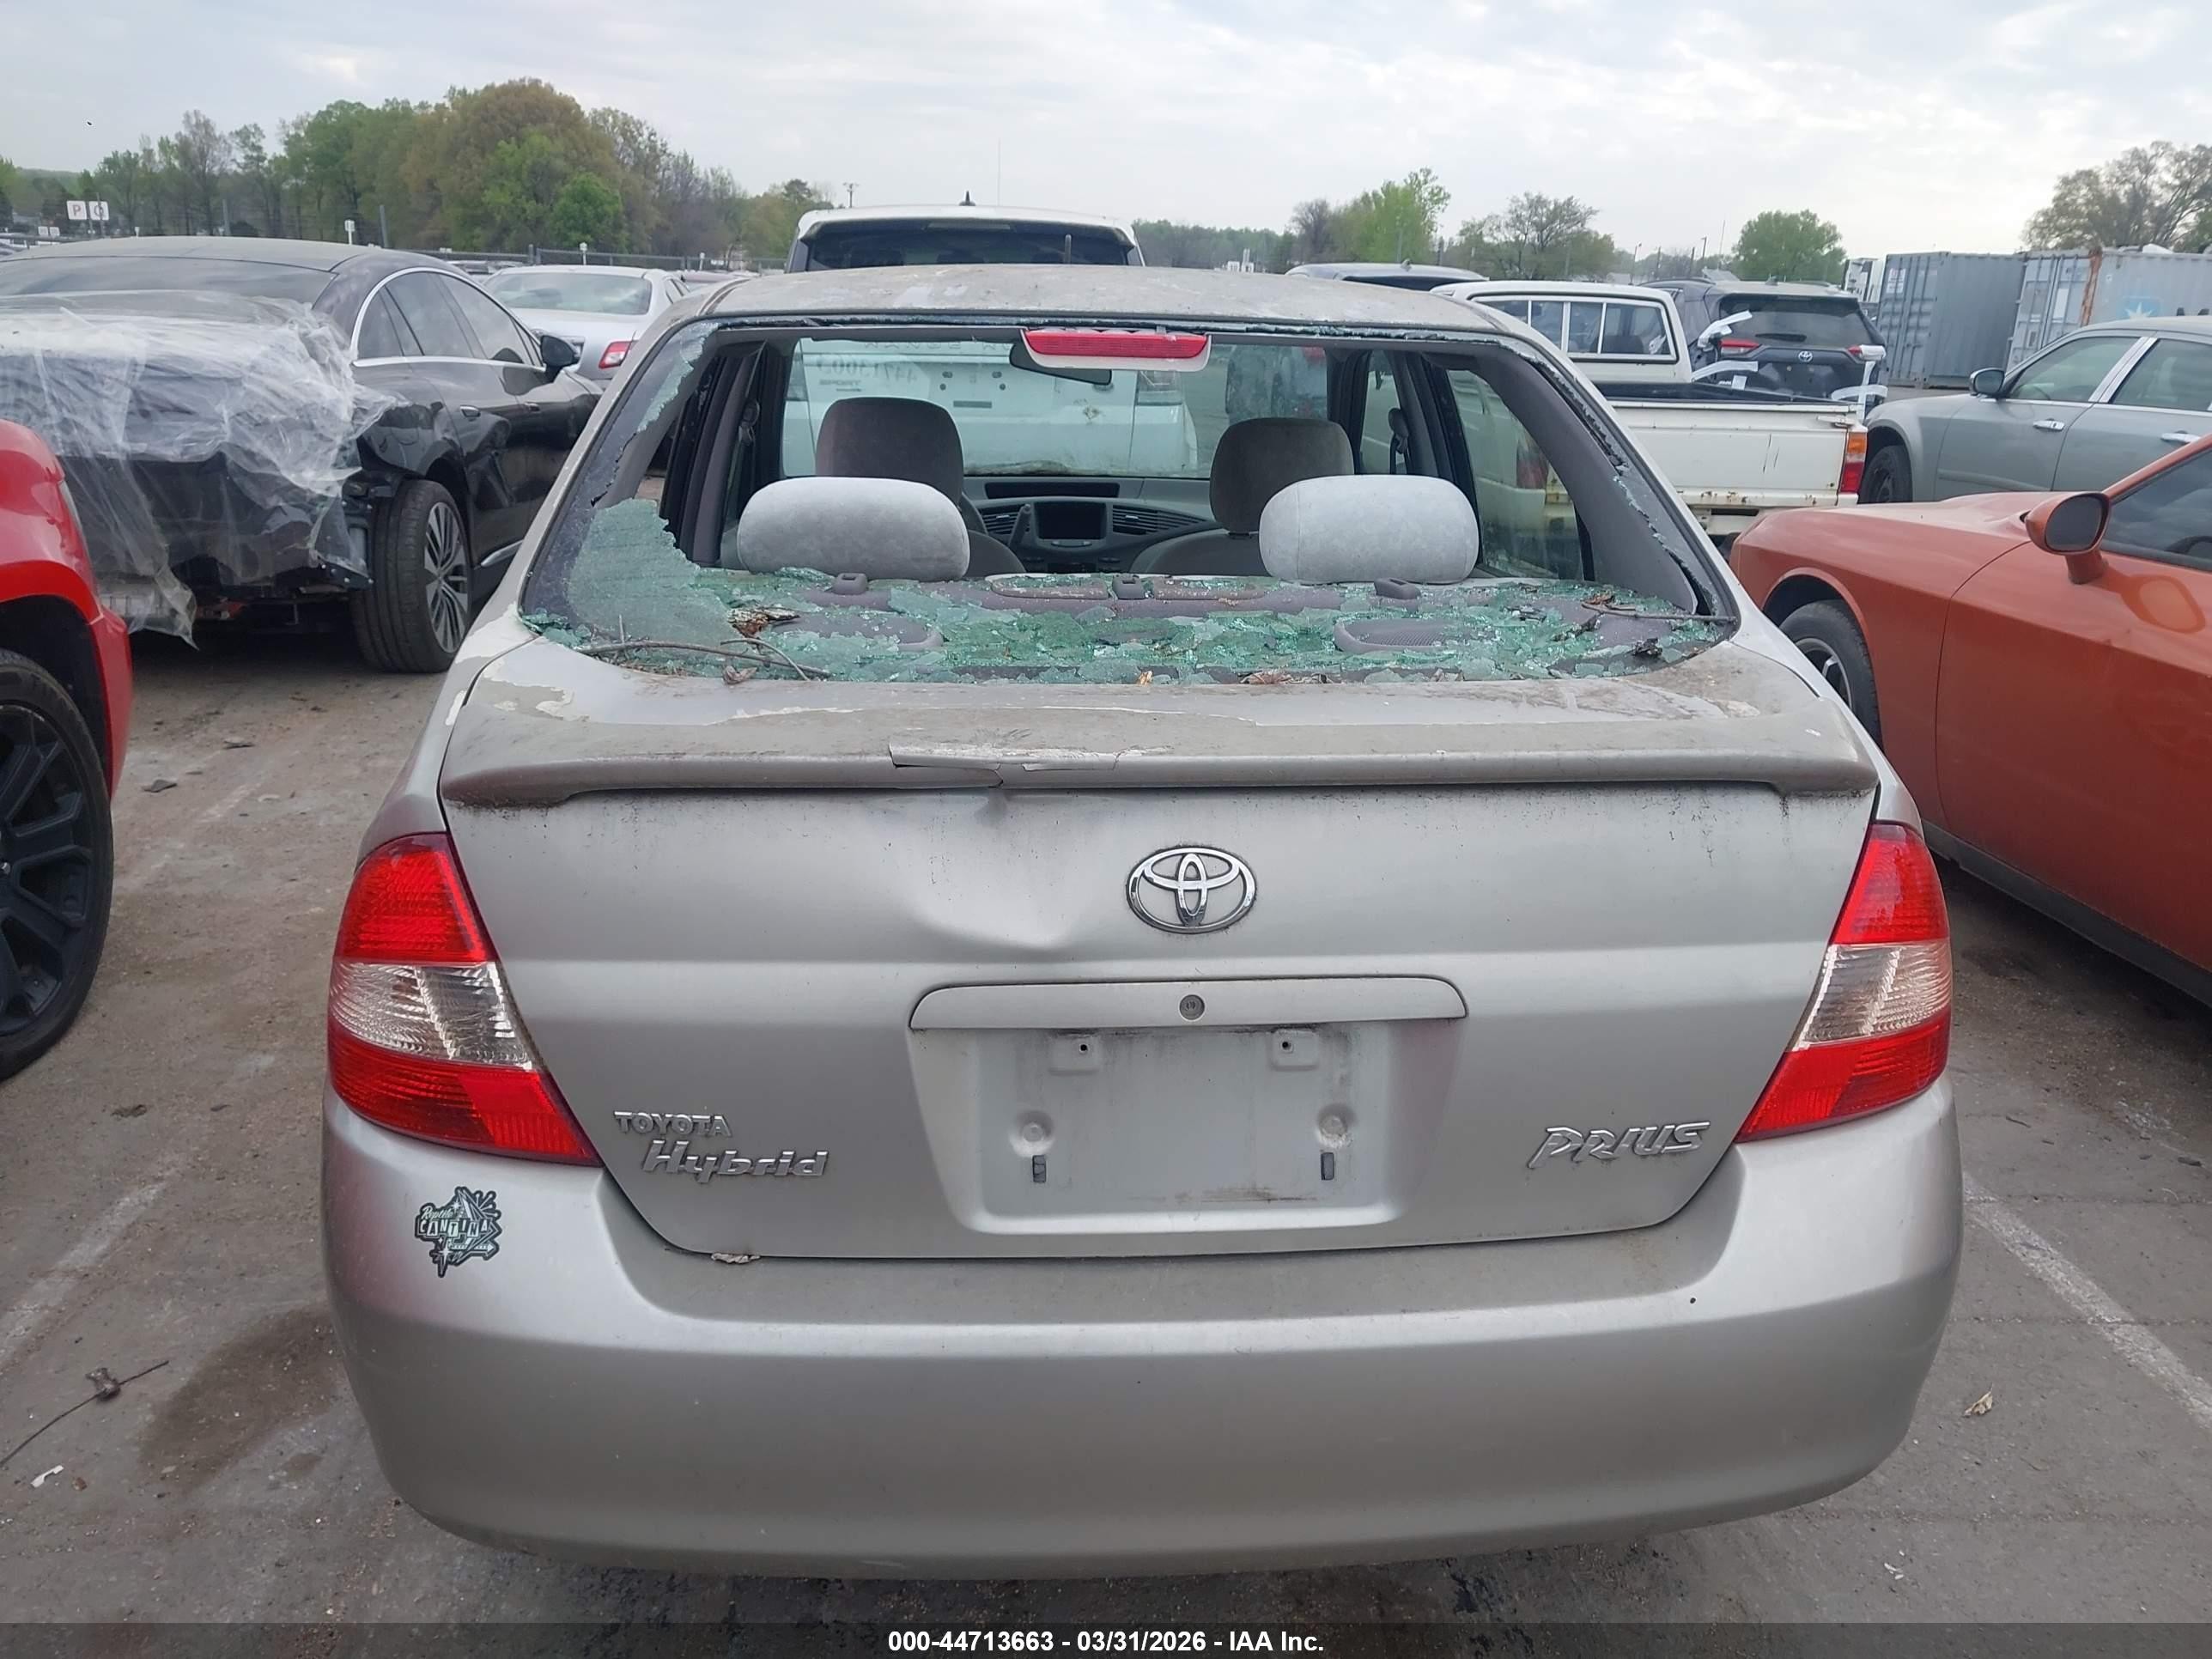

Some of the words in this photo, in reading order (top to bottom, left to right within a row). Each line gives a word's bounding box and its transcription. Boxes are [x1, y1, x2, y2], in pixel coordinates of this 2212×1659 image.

[72, 204, 82, 216] P
[614, 1111, 731, 1135] TOYOTA
[1528, 1121, 1711, 1169] PRIUS
[643, 1139, 828, 1183] Hybrid
[421, 1206, 454, 1221] Reptile
[420, 1218, 489, 1237] CANTINA
